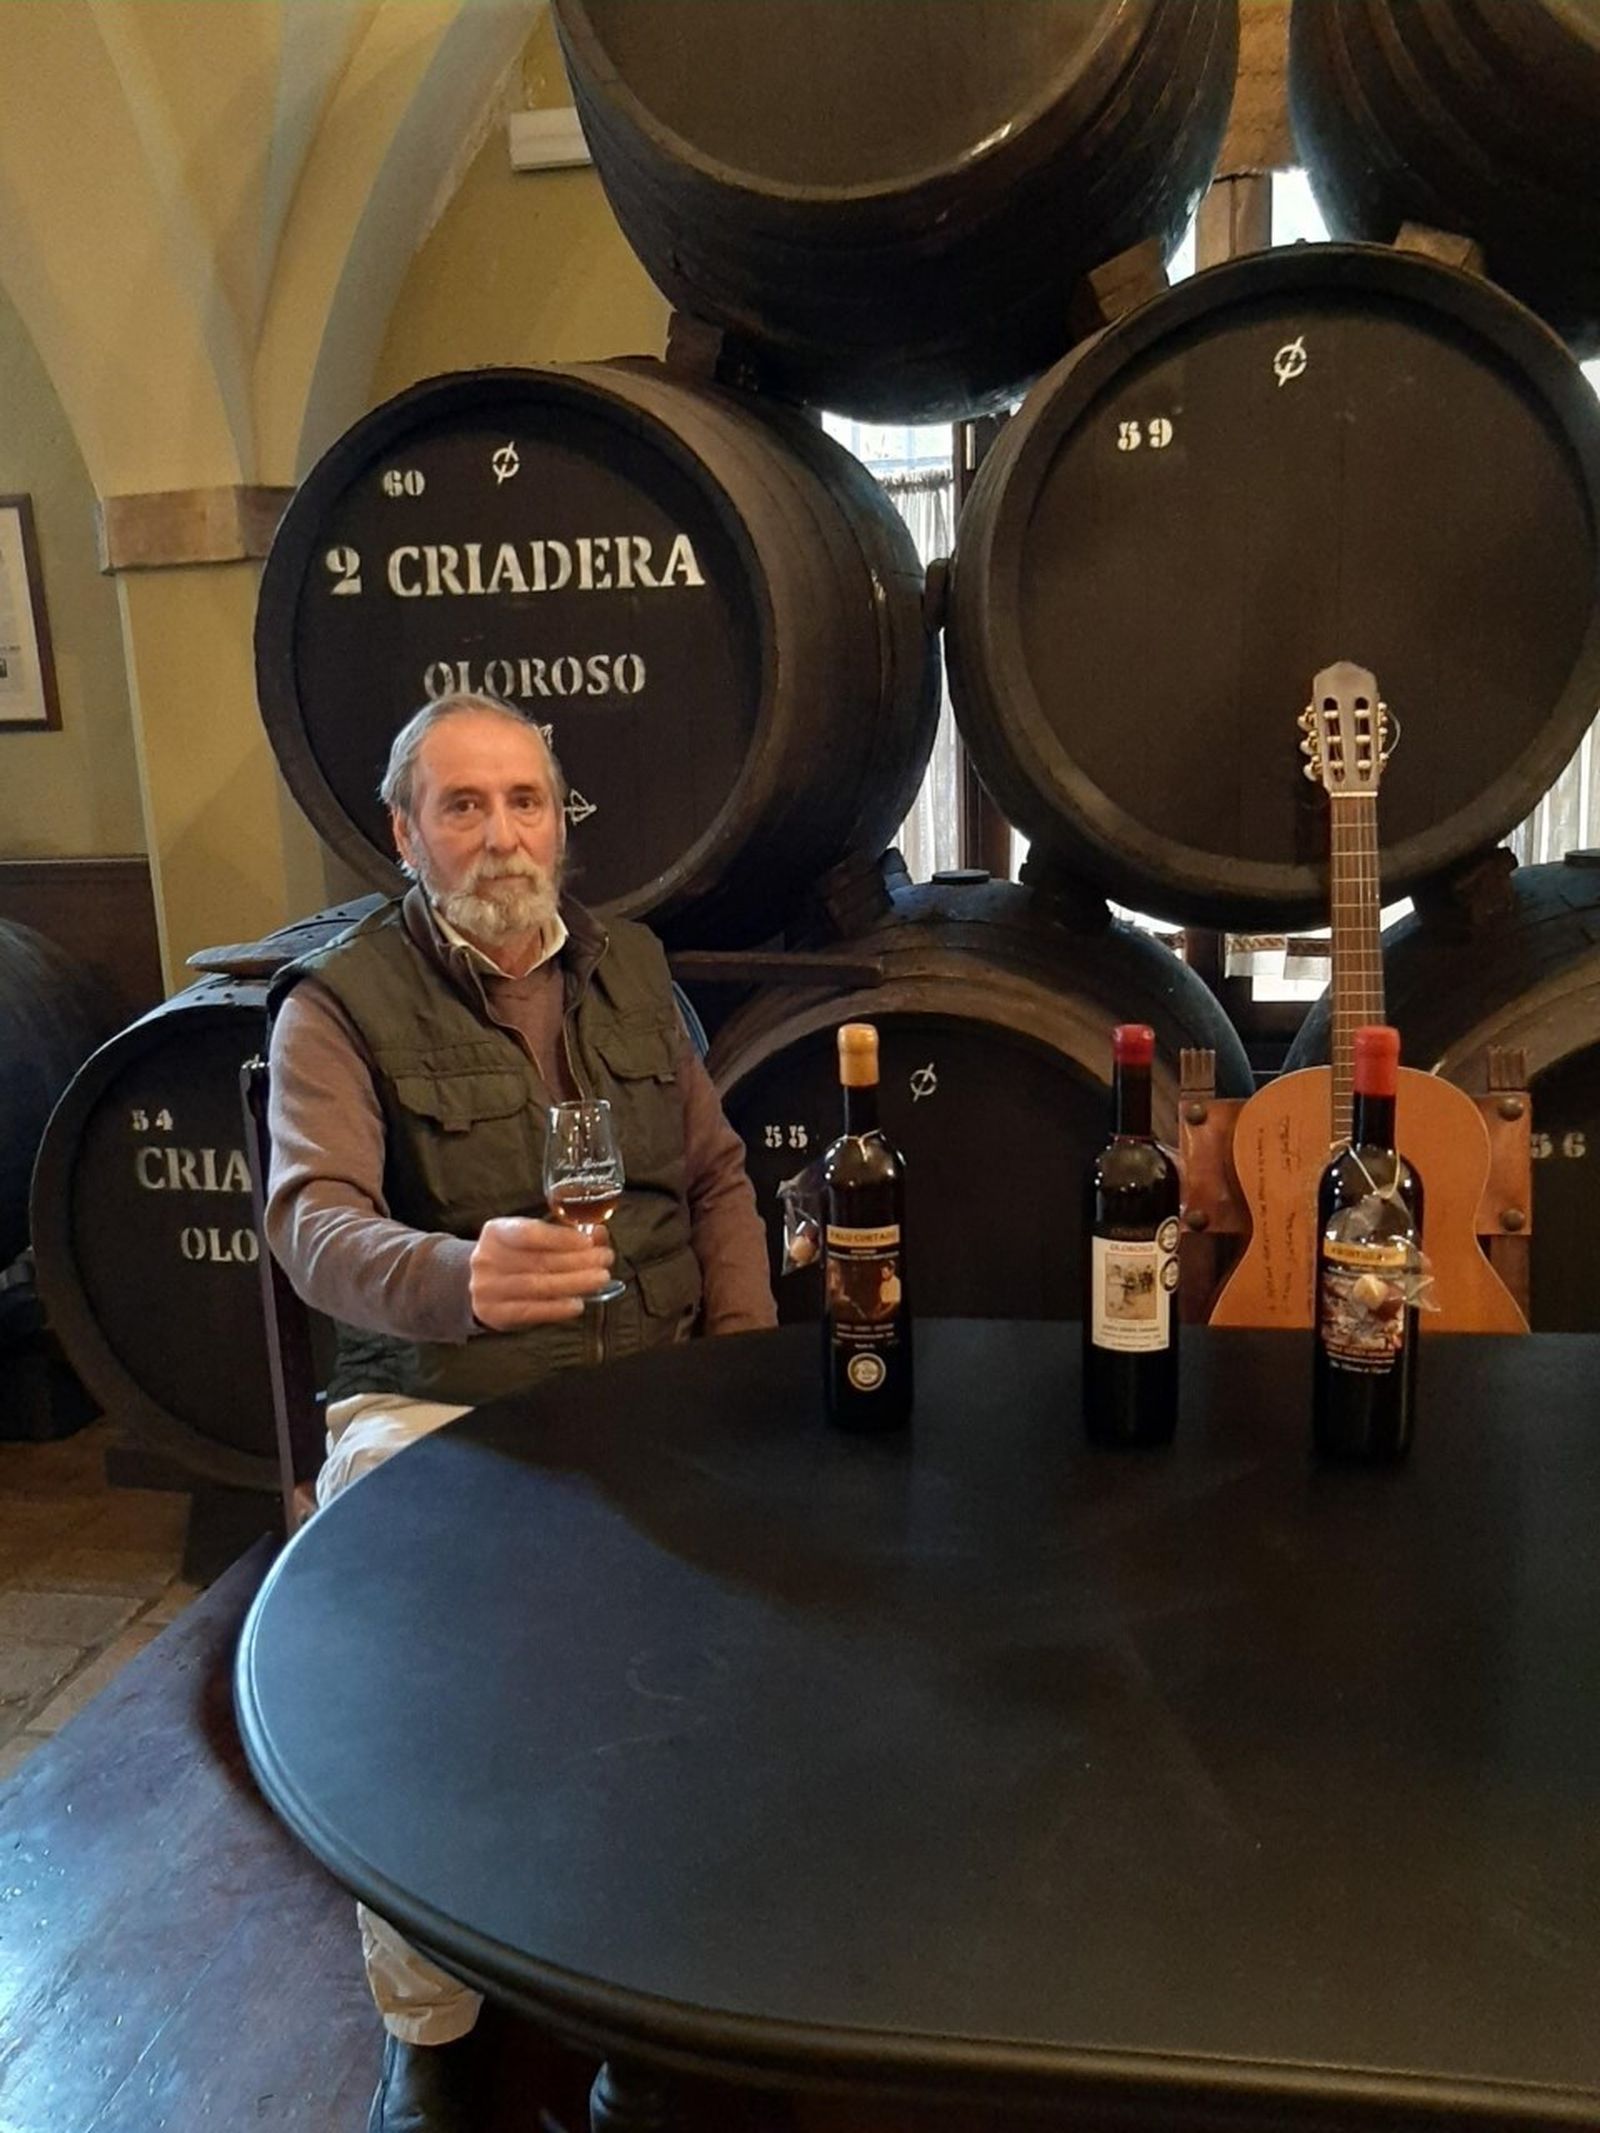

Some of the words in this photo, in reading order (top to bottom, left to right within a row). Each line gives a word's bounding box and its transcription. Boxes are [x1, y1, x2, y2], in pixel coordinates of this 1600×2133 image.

[382, 469, 425, 497] 60
[325, 545, 362, 596] 2
[387, 533, 706, 597] CRIADERA
[423, 653, 647, 699] OLOROSO
